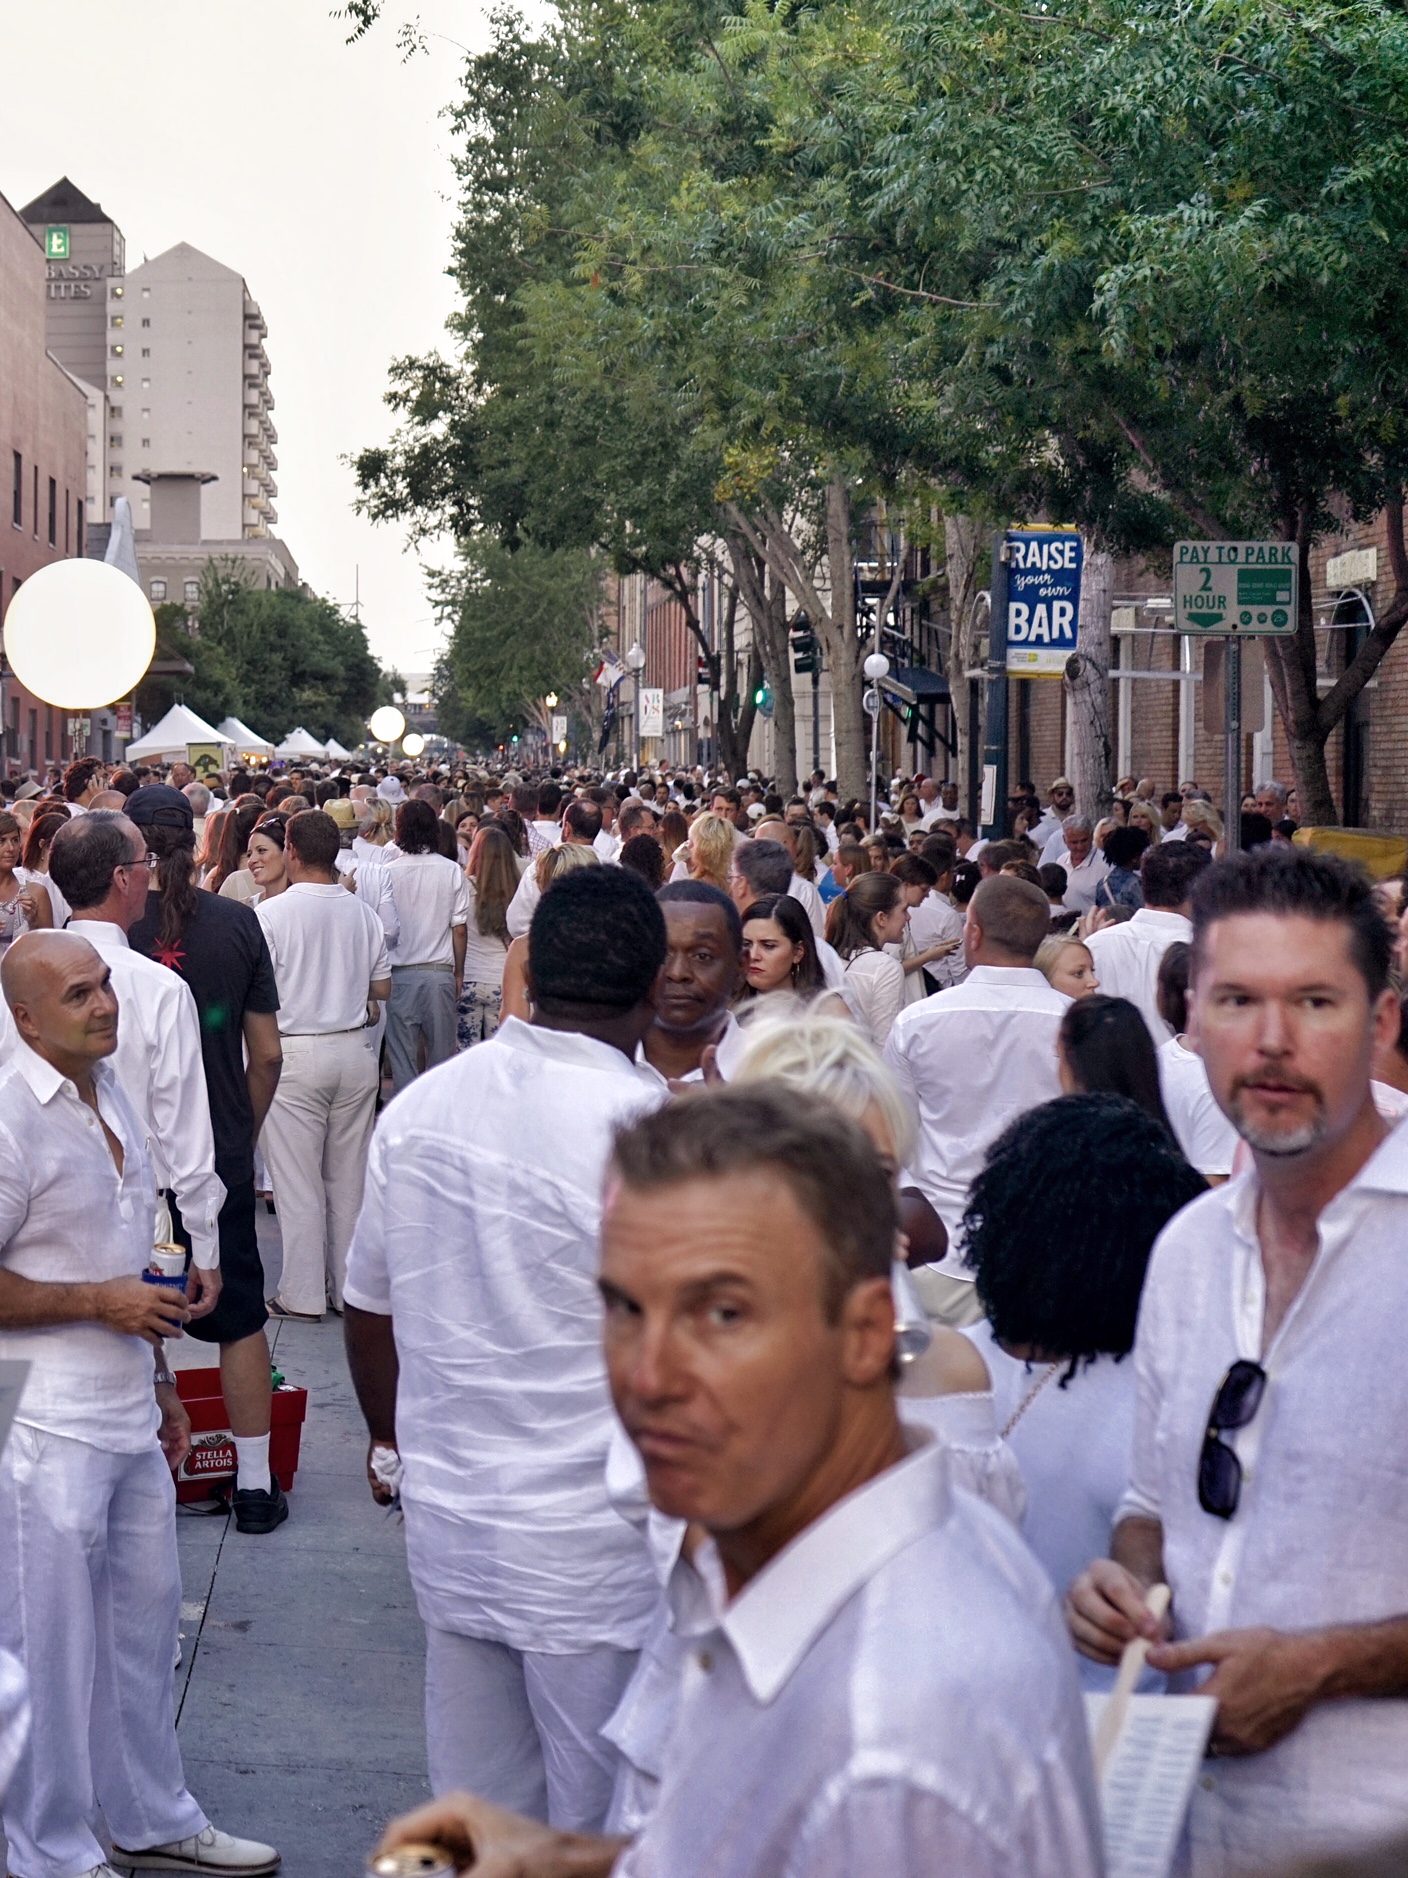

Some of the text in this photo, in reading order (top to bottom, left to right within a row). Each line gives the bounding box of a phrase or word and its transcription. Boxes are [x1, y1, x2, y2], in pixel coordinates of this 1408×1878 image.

[45, 265, 104, 279] BASSY
[48, 283, 92, 298] ITES
[1010, 541, 1078, 570] RAISE
[1179, 545, 1293, 563] PAY TO PARK
[1014, 573, 1055, 591] your
[1198, 567, 1213, 592] 2
[1038, 585, 1072, 597] own
[1182, 595, 1227, 610] HOUR
[1007, 600, 1074, 643] BAR
[195, 1450, 233, 1461] STELLA
[194, 1458, 233, 1469] ARTOIS
